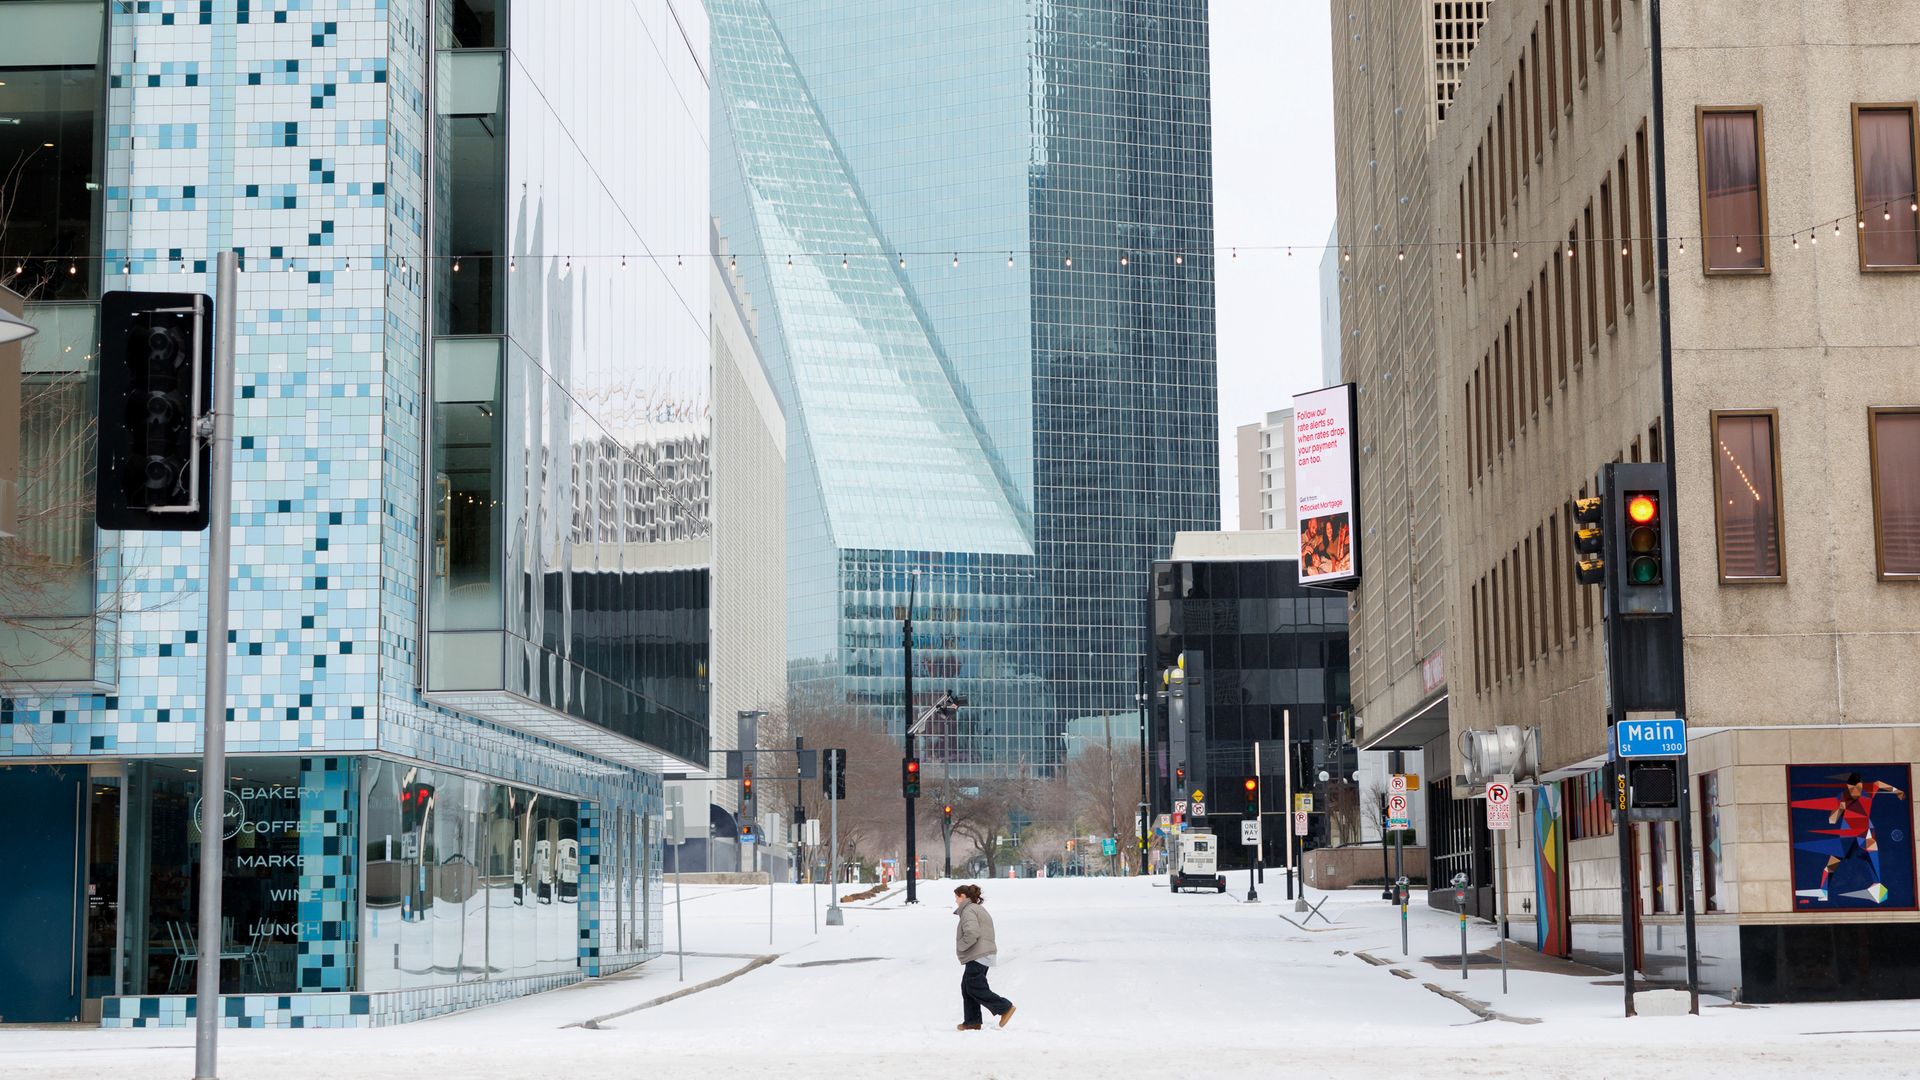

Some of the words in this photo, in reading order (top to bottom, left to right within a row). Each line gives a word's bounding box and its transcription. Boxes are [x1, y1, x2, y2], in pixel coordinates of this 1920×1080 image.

[1297, 410, 1315, 421] Follow
[1316, 407, 1326, 416] our
[1297, 423, 1309, 432] rate
[1310, 419, 1326, 430] alerts
[1326, 418, 1335, 426] so
[1298, 434, 1314, 443] when
[1315, 430, 1329, 440] rates
[1298, 446, 1311, 457] your
[1312, 440, 1337, 453] payment
[1298, 457, 1309, 466] can
[1320, 499, 1343, 509] Mortgage
[1628, 722, 1674, 741] Main
[1622, 744, 1631, 752] St
[1662, 743, 1683, 751] 1300
[241, 787, 321, 799] BAKERY
[241, 820, 321, 834] COFFEE
[270, 889, 321, 901] WINE
[249, 923, 320, 936] LUNCH
